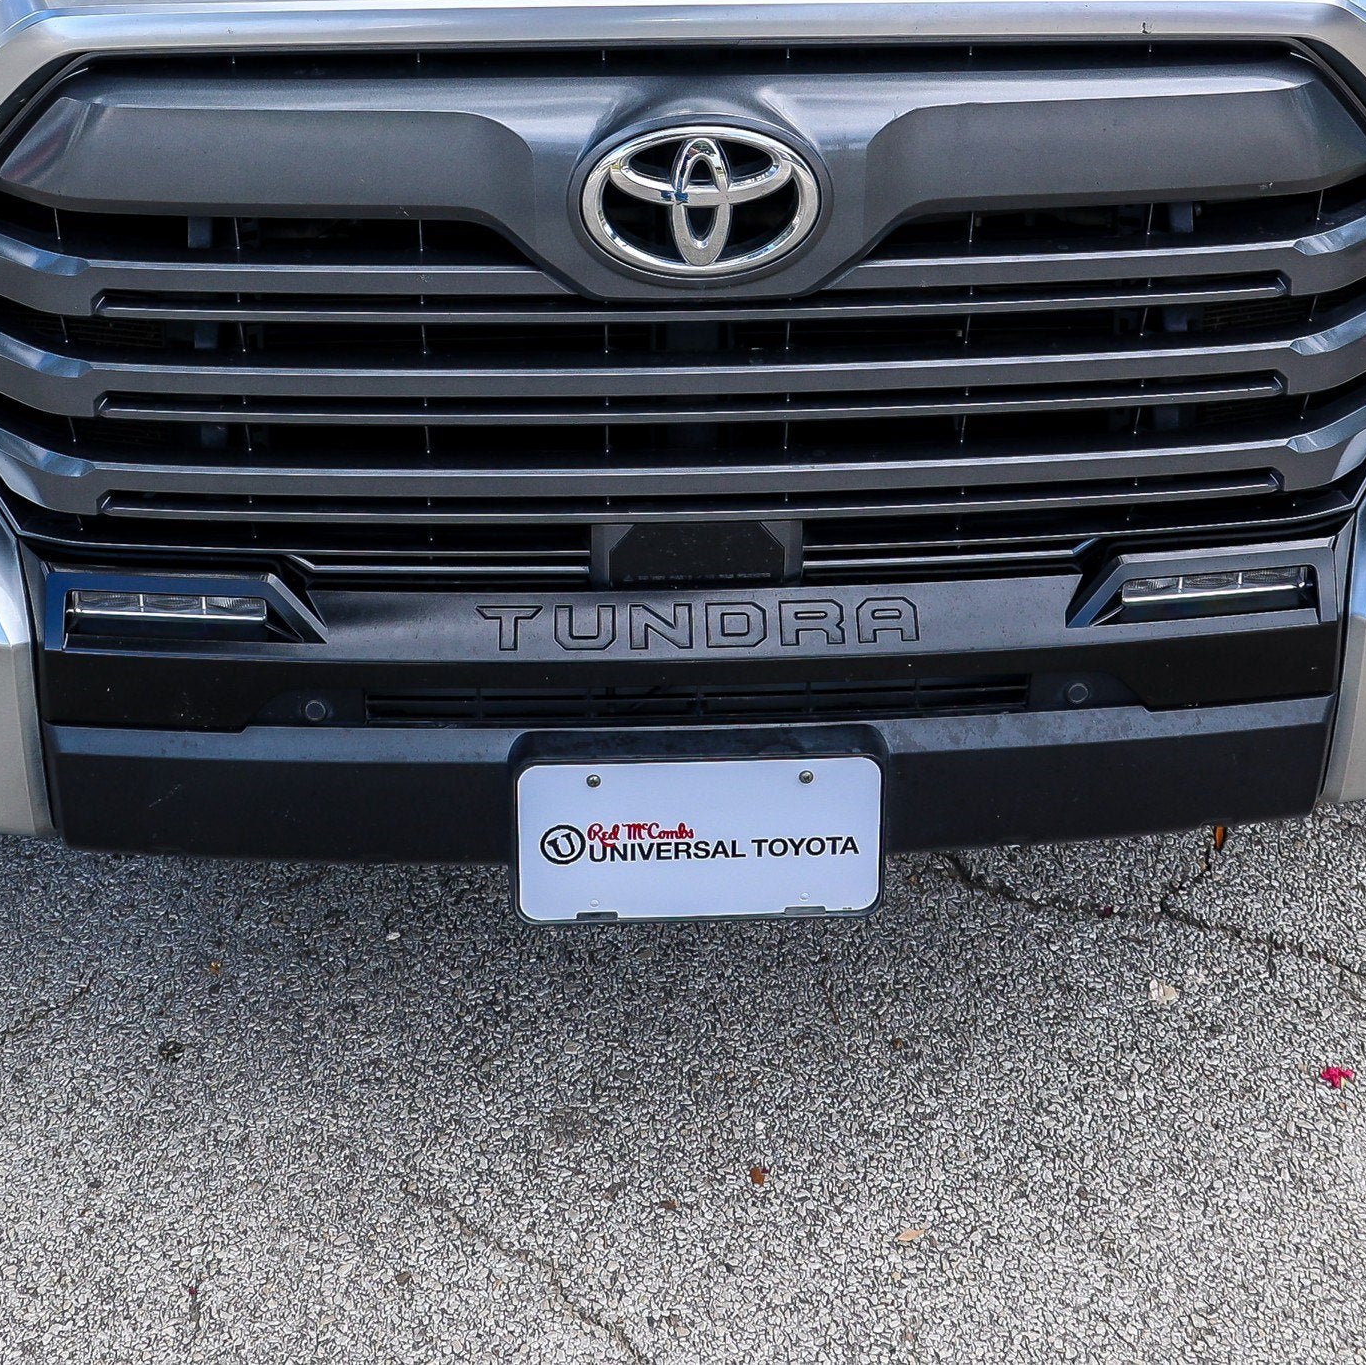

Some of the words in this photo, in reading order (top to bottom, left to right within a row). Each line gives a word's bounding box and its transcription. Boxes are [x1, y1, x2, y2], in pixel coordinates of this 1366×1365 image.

[475, 596, 920, 652] TUNDRA
[587, 823, 619, 848] Red
[589, 839, 746, 863] UNIVERSAL
[751, 835, 859, 858] TOYOTA
